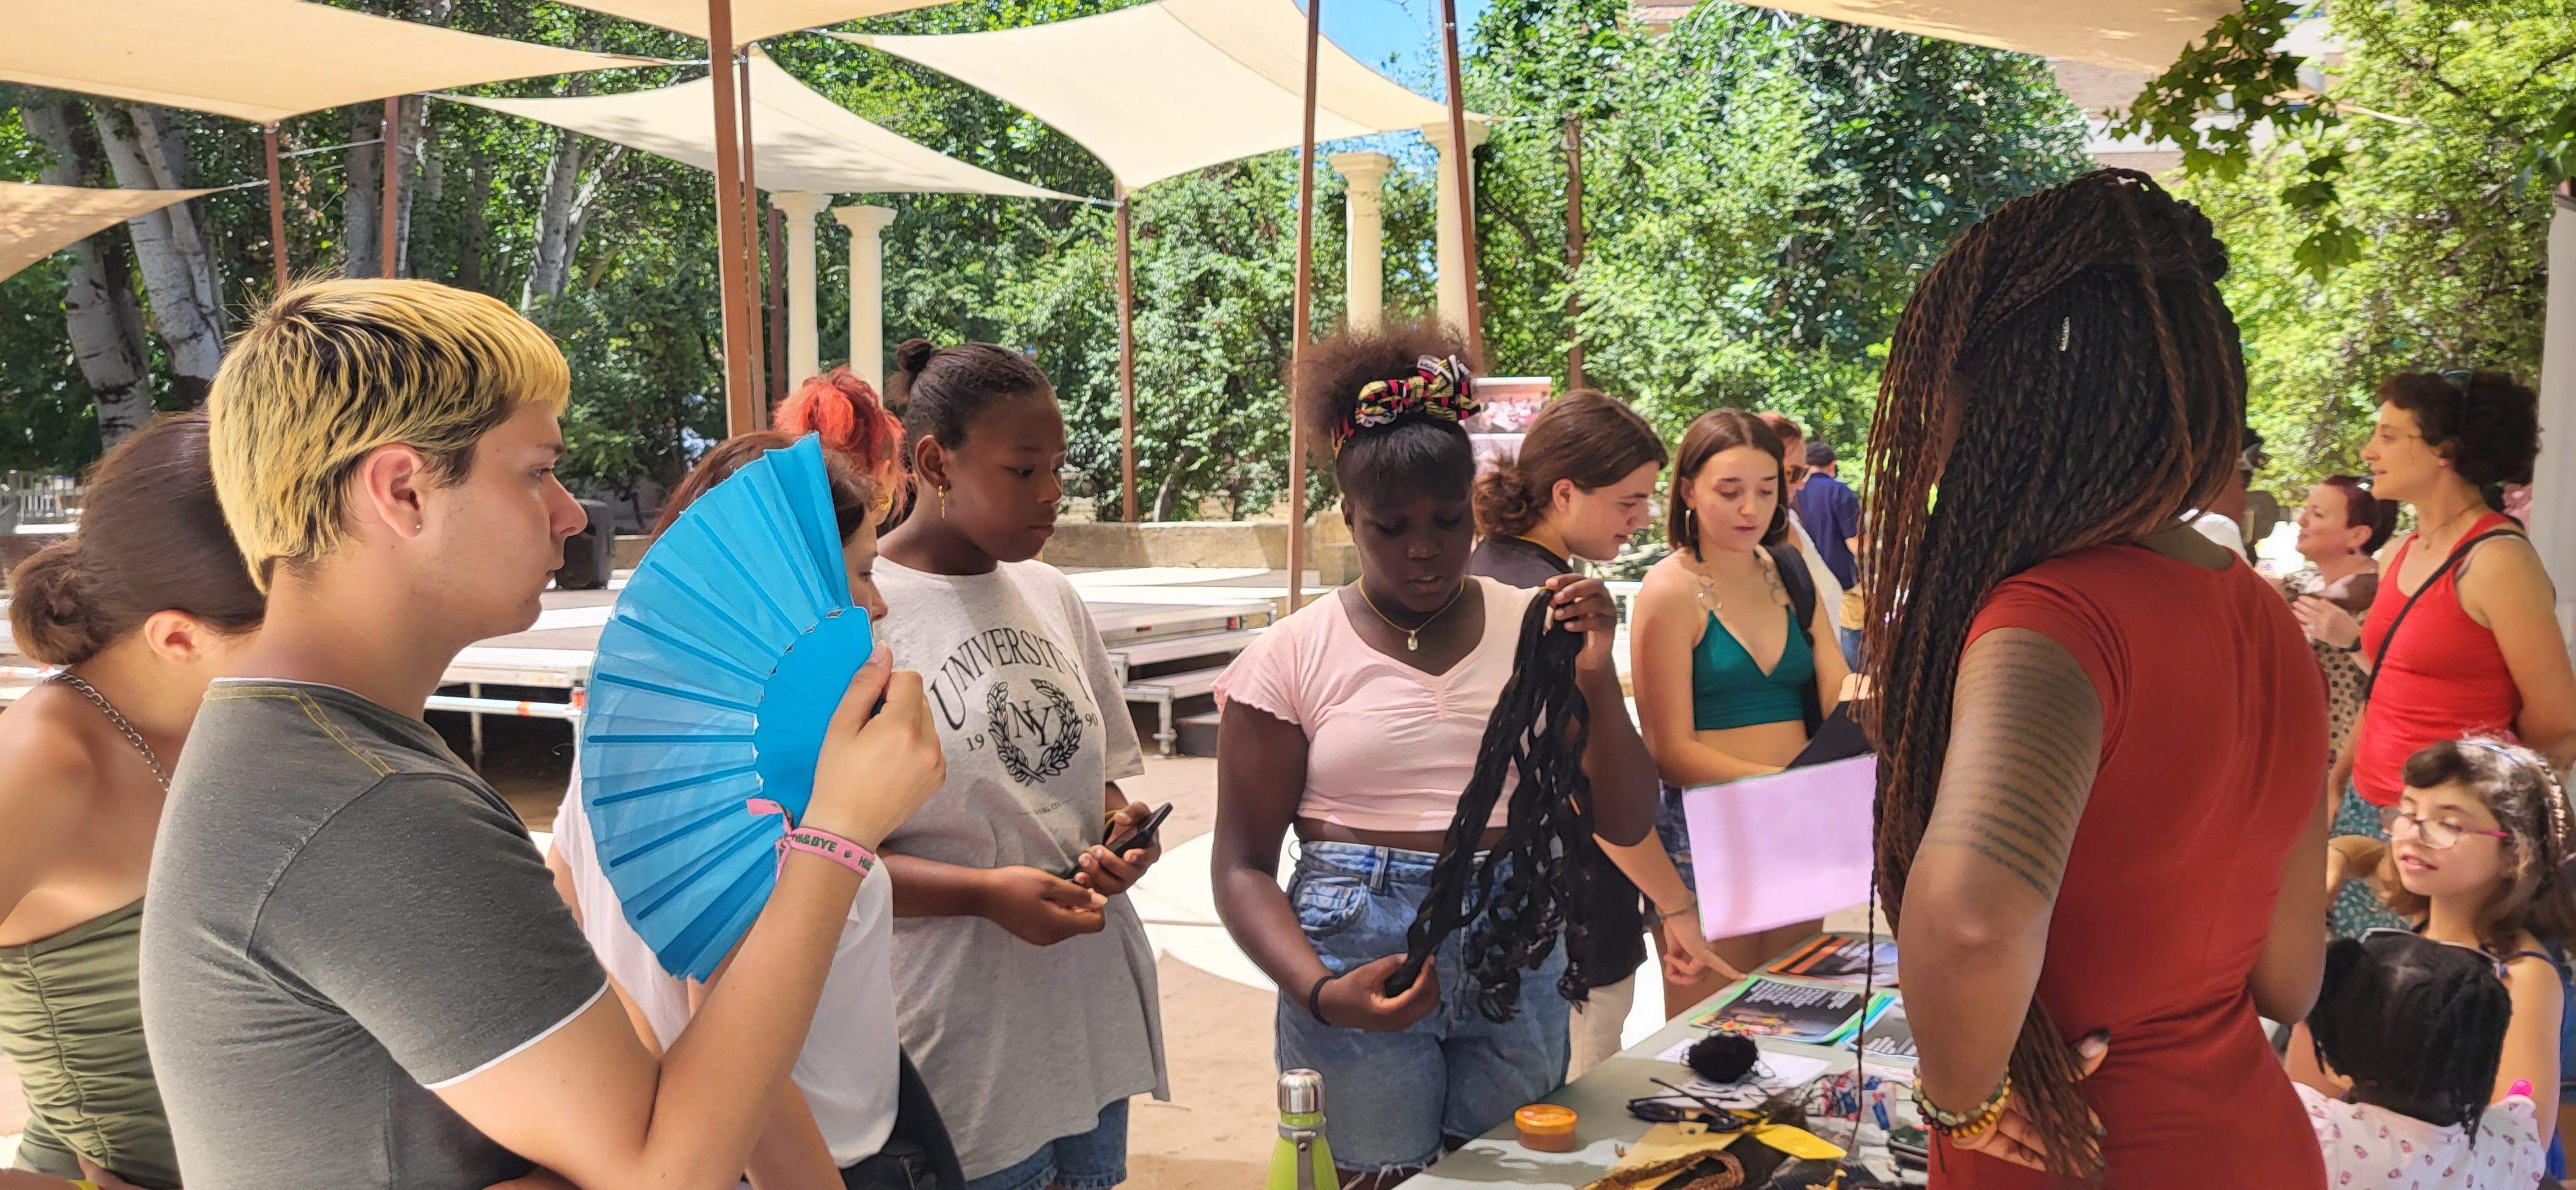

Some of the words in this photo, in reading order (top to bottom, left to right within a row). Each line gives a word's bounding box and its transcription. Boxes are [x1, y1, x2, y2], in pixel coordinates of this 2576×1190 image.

[929, 627, 1095, 730] UNIVERSITY
[1084, 713, 1099, 727] 90
[965, 733, 985, 751] 19
